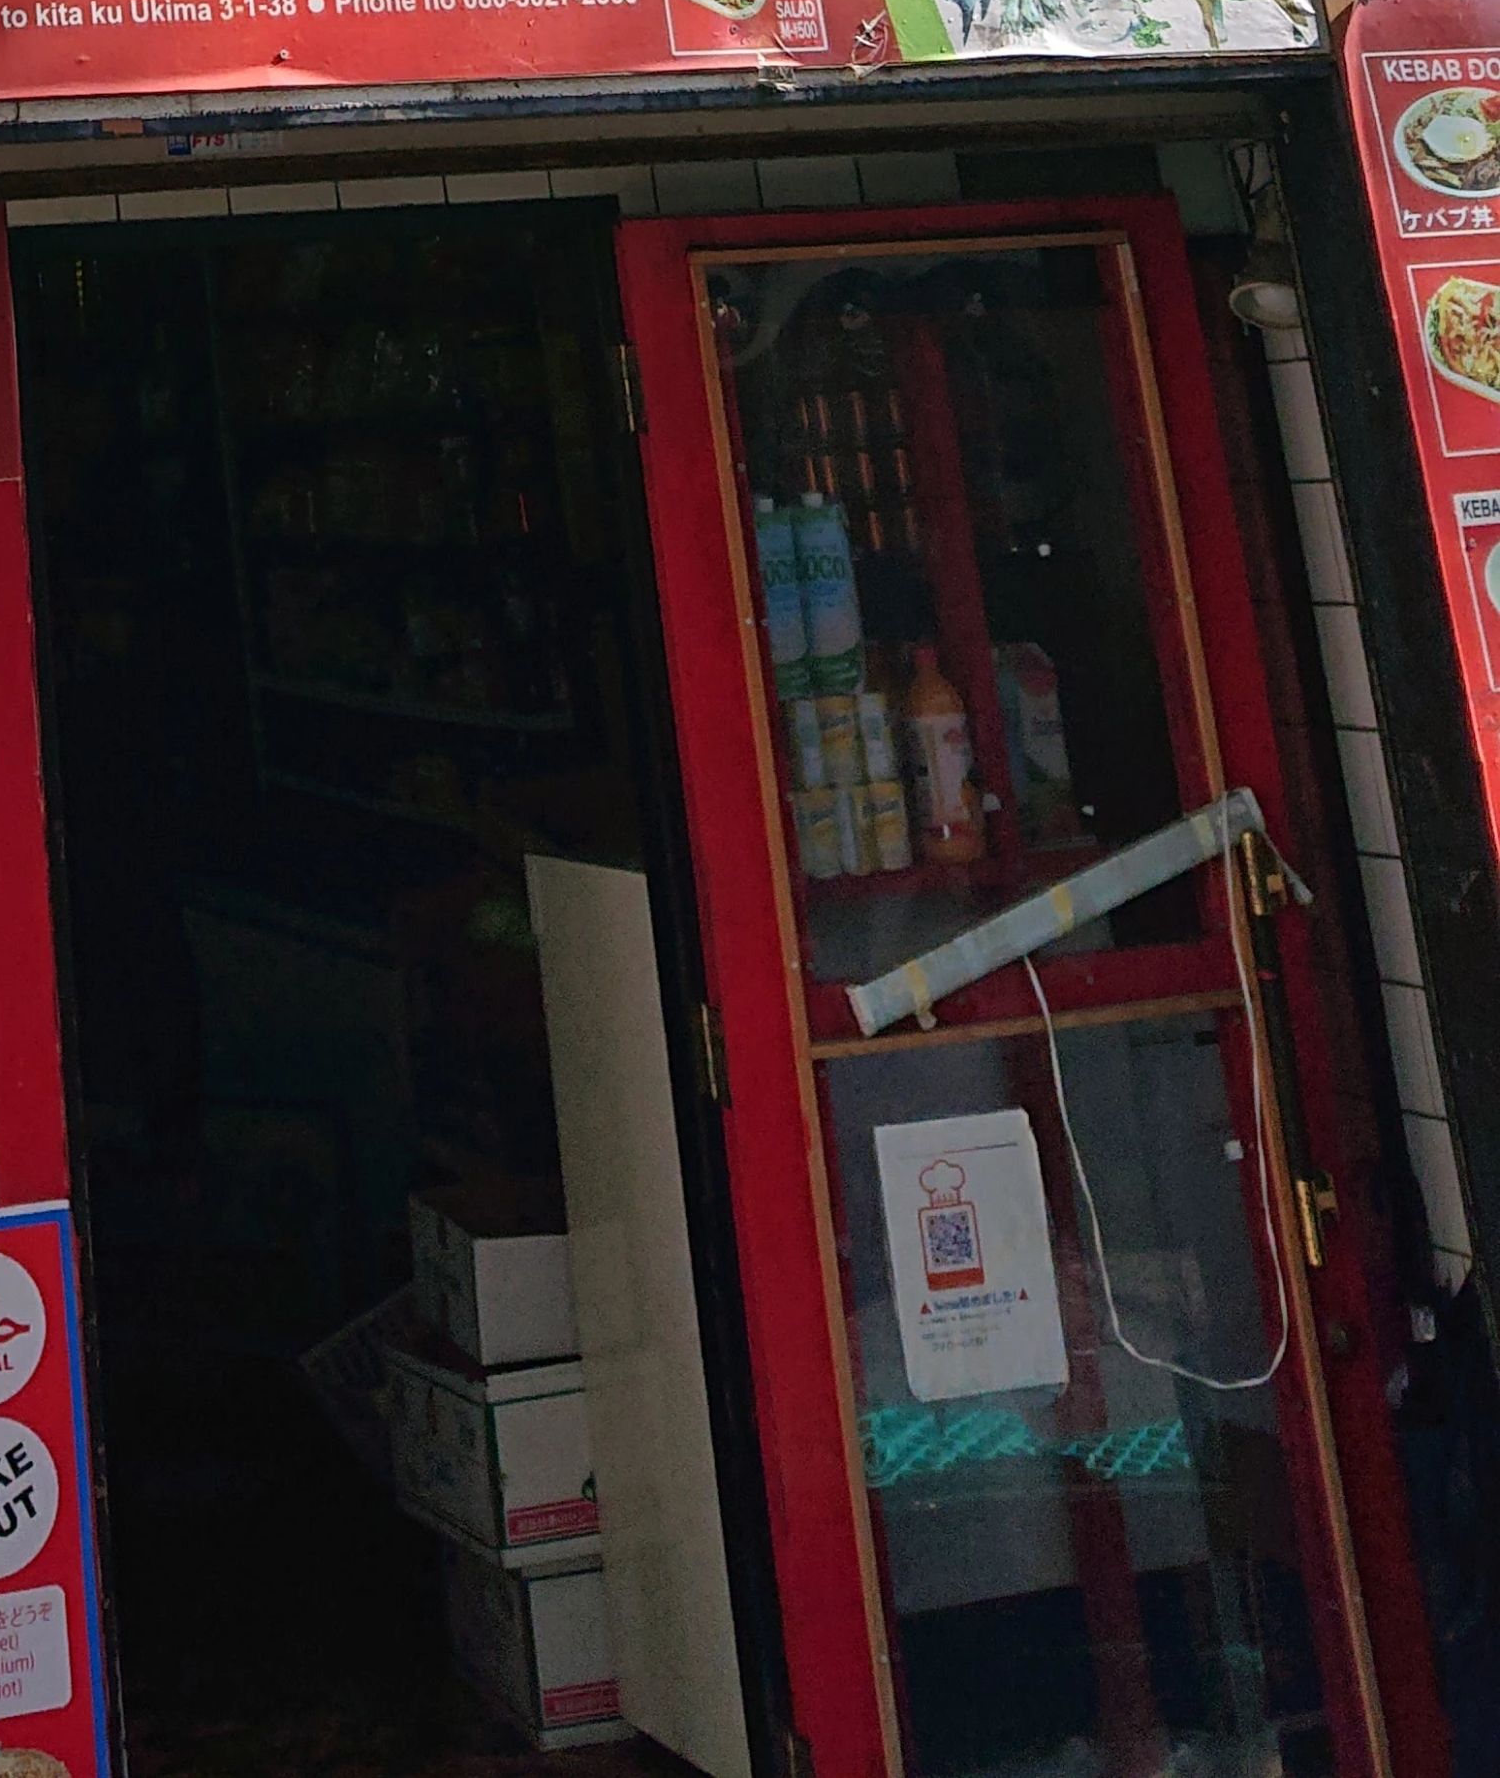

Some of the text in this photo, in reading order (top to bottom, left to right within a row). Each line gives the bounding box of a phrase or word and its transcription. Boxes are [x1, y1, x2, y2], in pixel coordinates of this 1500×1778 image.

[1, 5, 28, 30] to
[35, 1, 84, 28] kita
[90, 0, 123, 25] ku
[775, 0, 817, 20] SALAD
[1382, 58, 1462, 83] KEBAB
[1403, 205, 1495, 232] ケバブ丼
